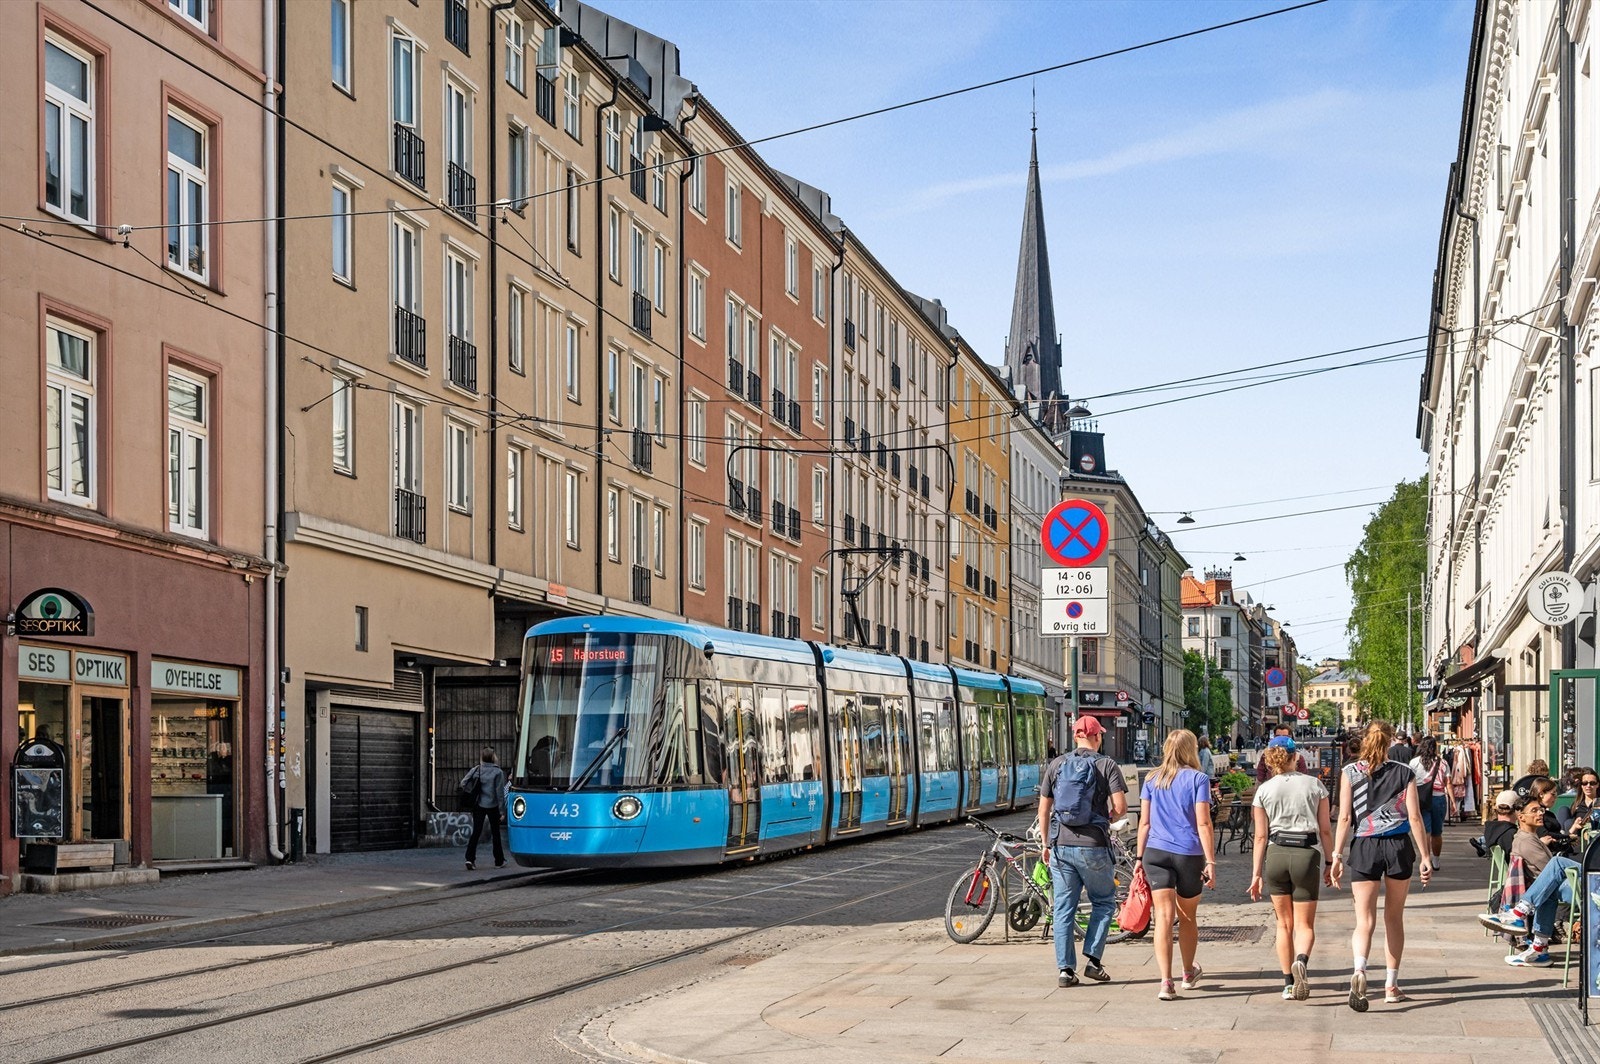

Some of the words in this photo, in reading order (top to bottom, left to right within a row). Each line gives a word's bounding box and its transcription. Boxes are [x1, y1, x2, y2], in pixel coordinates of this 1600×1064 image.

[1058, 571, 1068, 581] 14
[1077, 571, 1092, 581] 06
[1056, 584, 1093, 595] (12-06)
[1538, 576, 1571, 590] CULTIVATE
[1548, 614, 1568, 623] FOOD
[1053, 621, 1079, 633] Øvrig
[1083, 621, 1096, 631] tid
[550, 648, 564, 662] 15
[573, 648, 626, 662] Majorstuen
[28, 652, 56, 674] SES
[76, 657, 122, 680] OPTIKK
[165, 668, 222, 691] ØYEHELSE
[549, 803, 580, 818] 443
[550, 831, 573, 841] CAF
